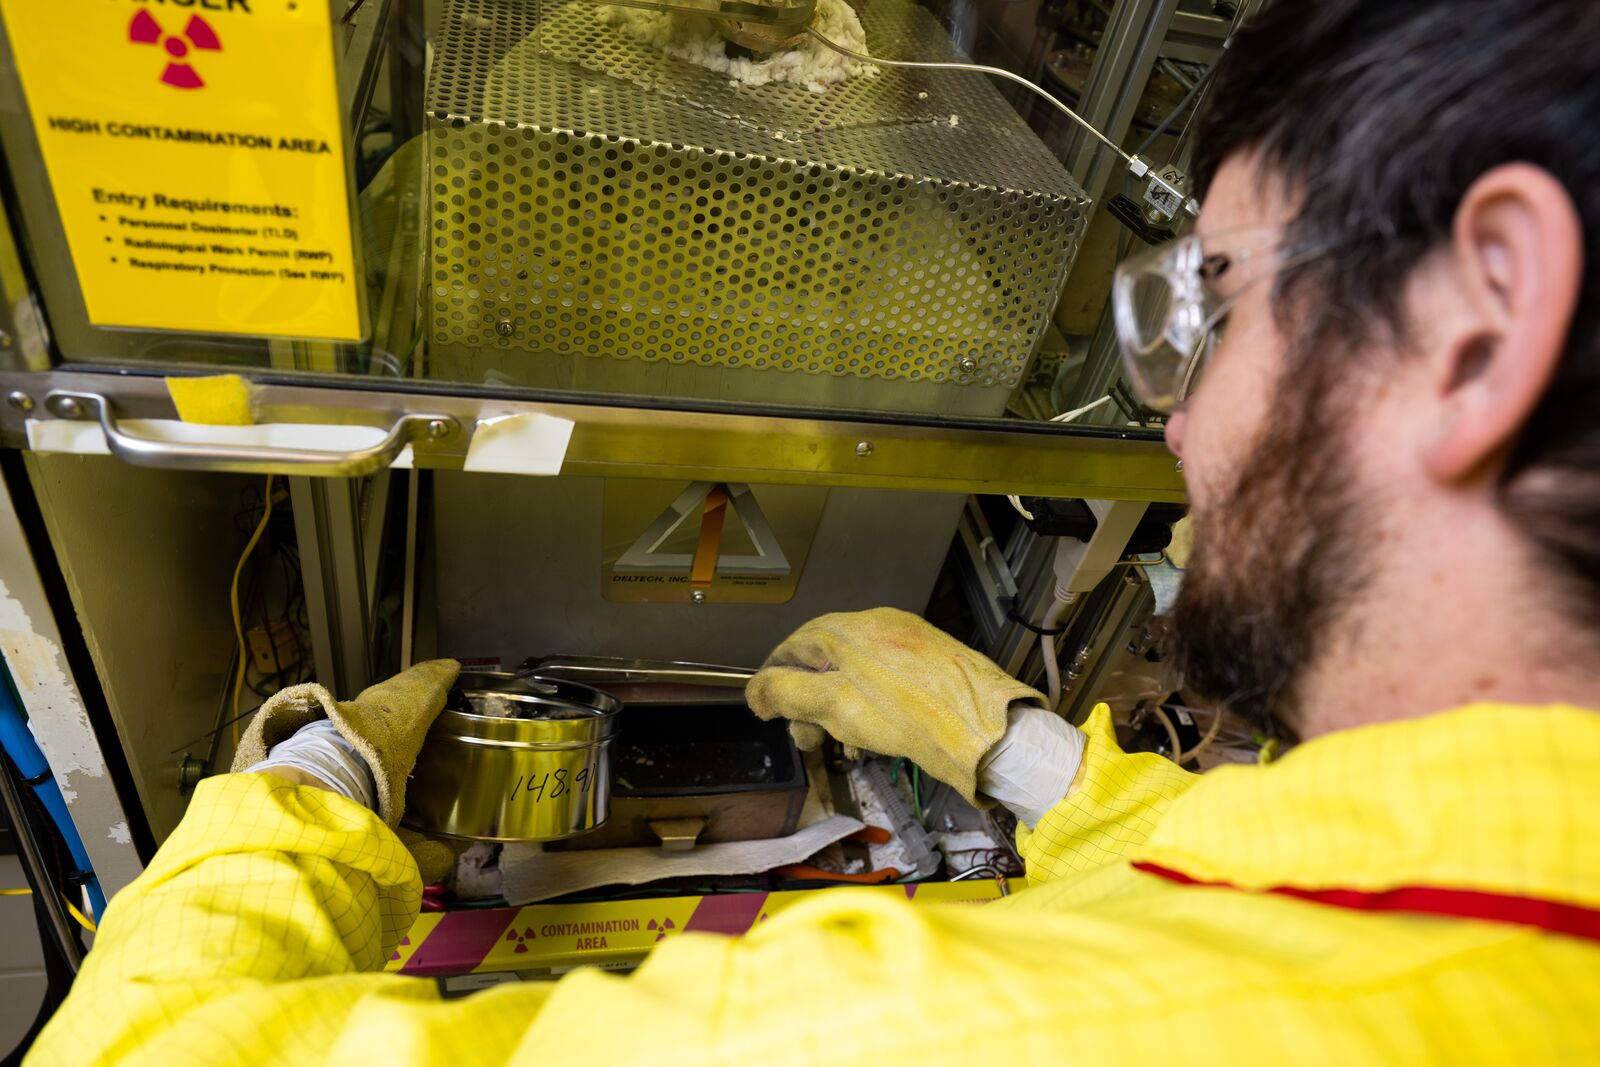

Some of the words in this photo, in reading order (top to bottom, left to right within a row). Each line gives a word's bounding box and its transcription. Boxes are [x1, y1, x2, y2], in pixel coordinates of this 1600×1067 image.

[49, 117, 100, 134] HIGH
[106, 121, 272, 149] CONTAMINATION
[277, 138, 331, 154] AREA
[92, 187, 146, 210] Entry
[153, 193, 299, 218] Requirements:
[118, 215, 187, 231] Personnel
[191, 221, 258, 236] Dosimeter
[262, 227, 297, 241] (TLD)
[124, 236, 206, 253] Radiological
[210, 243, 243, 256] Work
[247, 246, 290, 259] Permit
[294, 250, 333, 263] (RWP)
[129, 257, 204, 275] Respiratory
[209, 263, 276, 277] Protection
[279, 269, 306, 279] (See
[309, 270, 345, 284] RWP)
[613, 575, 665, 583] DELTECH,
[511, 763, 596, 802] 148.91
[541, 919, 640, 937] CONTAMINATION
[576, 936, 608, 950] AREA
